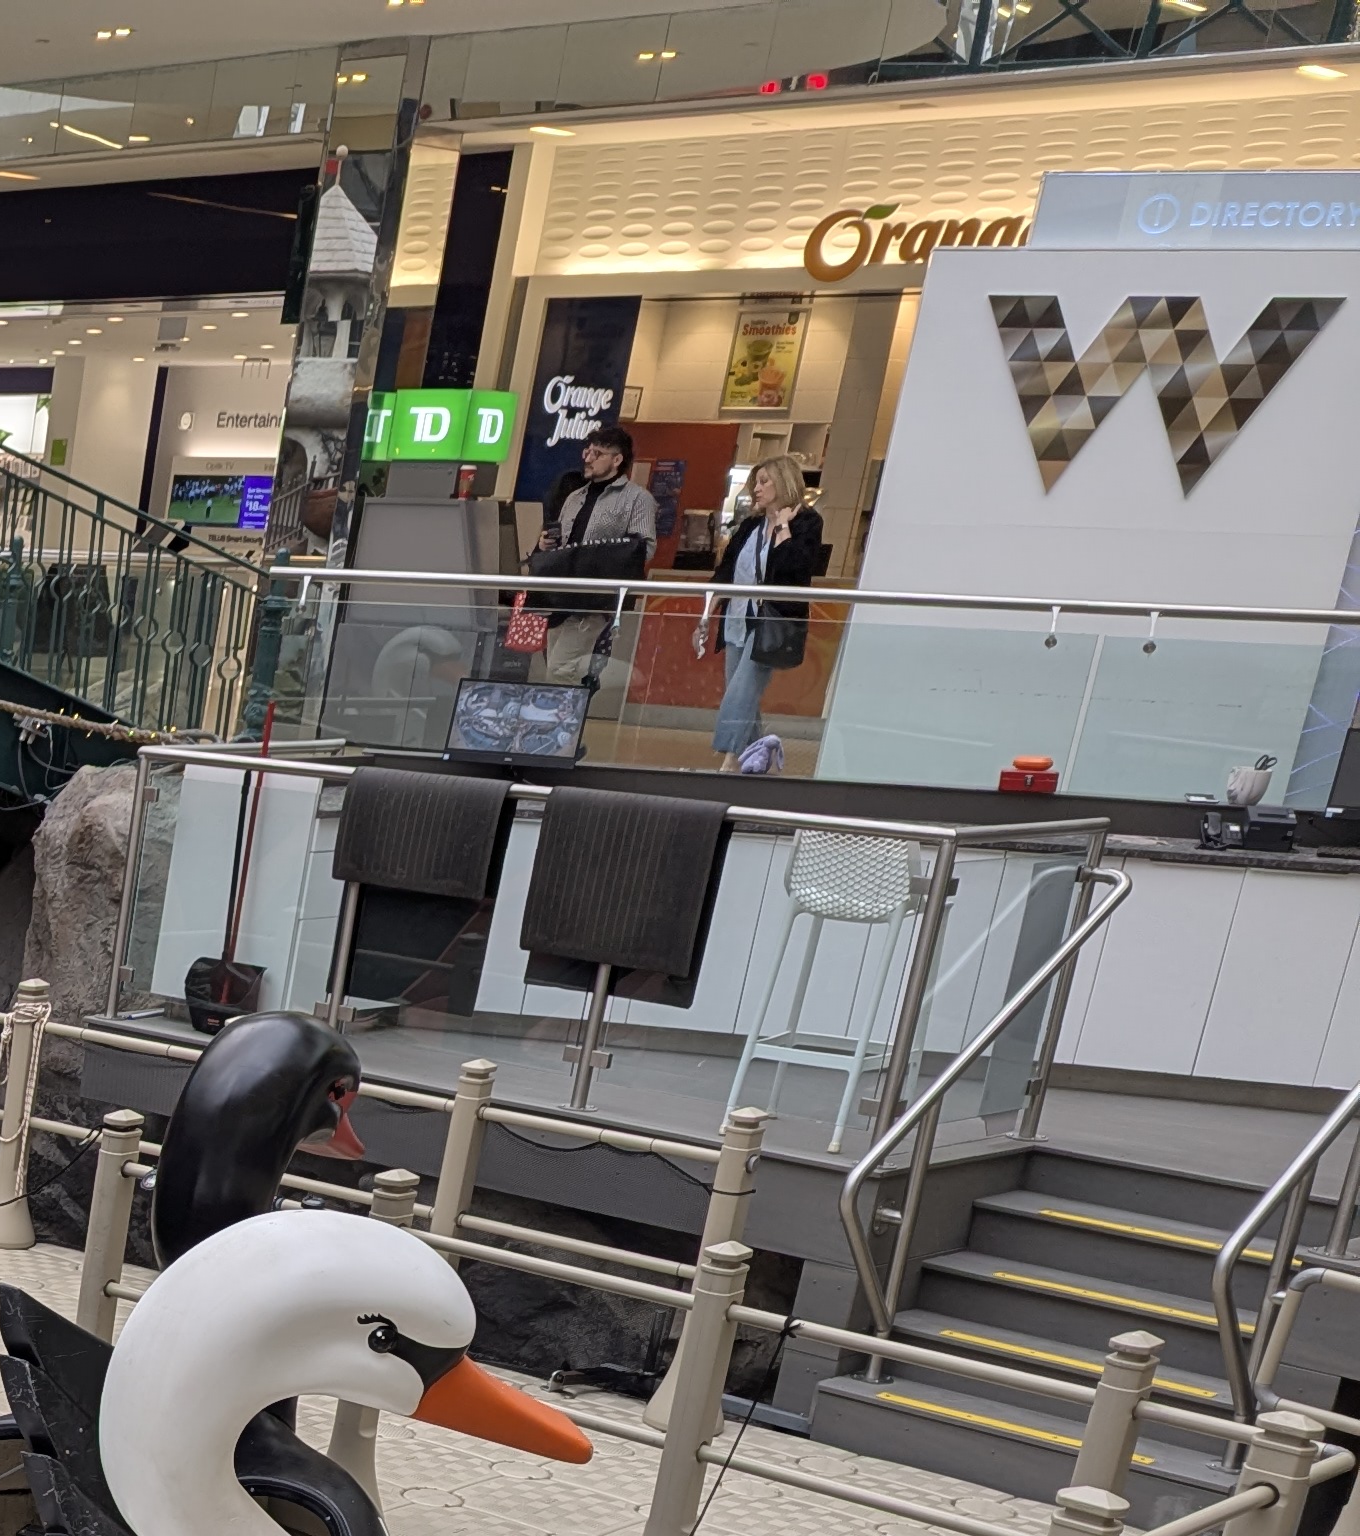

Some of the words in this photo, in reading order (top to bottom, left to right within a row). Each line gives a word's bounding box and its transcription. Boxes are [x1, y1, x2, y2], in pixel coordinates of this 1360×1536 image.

[1190, 201, 1360, 227] DIRECTORY
[803, 208, 1032, 283] Oran
[742, 323, 797, 336] Smoothies
[544, 374, 614, 417] Orange
[409, 406, 451, 442] TD
[477, 407, 504, 444] TD
